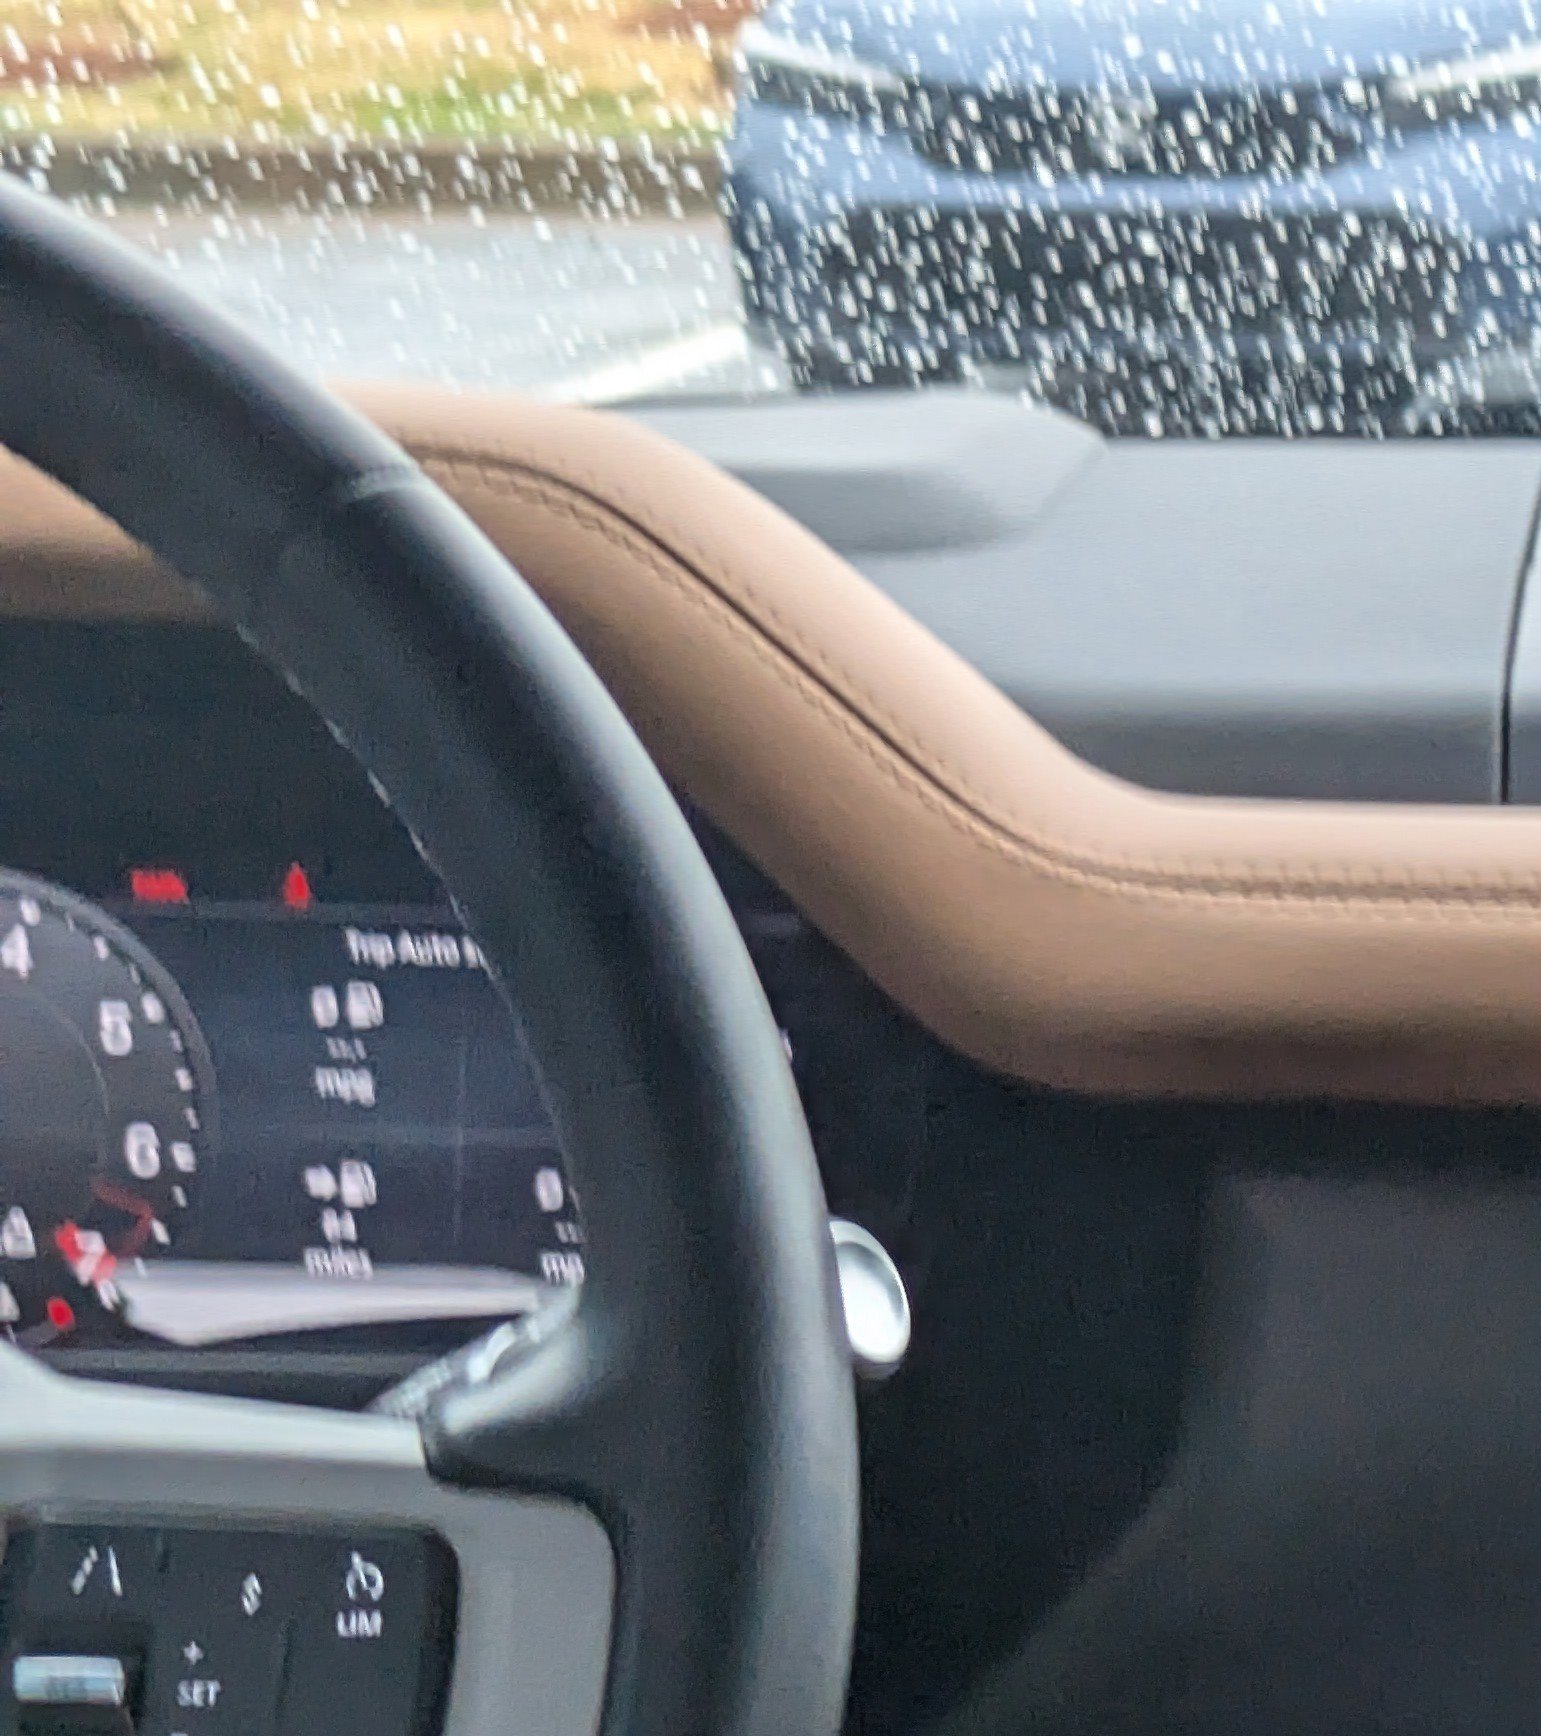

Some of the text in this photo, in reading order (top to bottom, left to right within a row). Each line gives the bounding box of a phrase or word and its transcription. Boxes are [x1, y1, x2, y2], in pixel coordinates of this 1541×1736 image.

[100, 999, 133, 1057] 5
[124, 1121, 161, 1180] 6
[176, 1679, 222, 1708] SET
